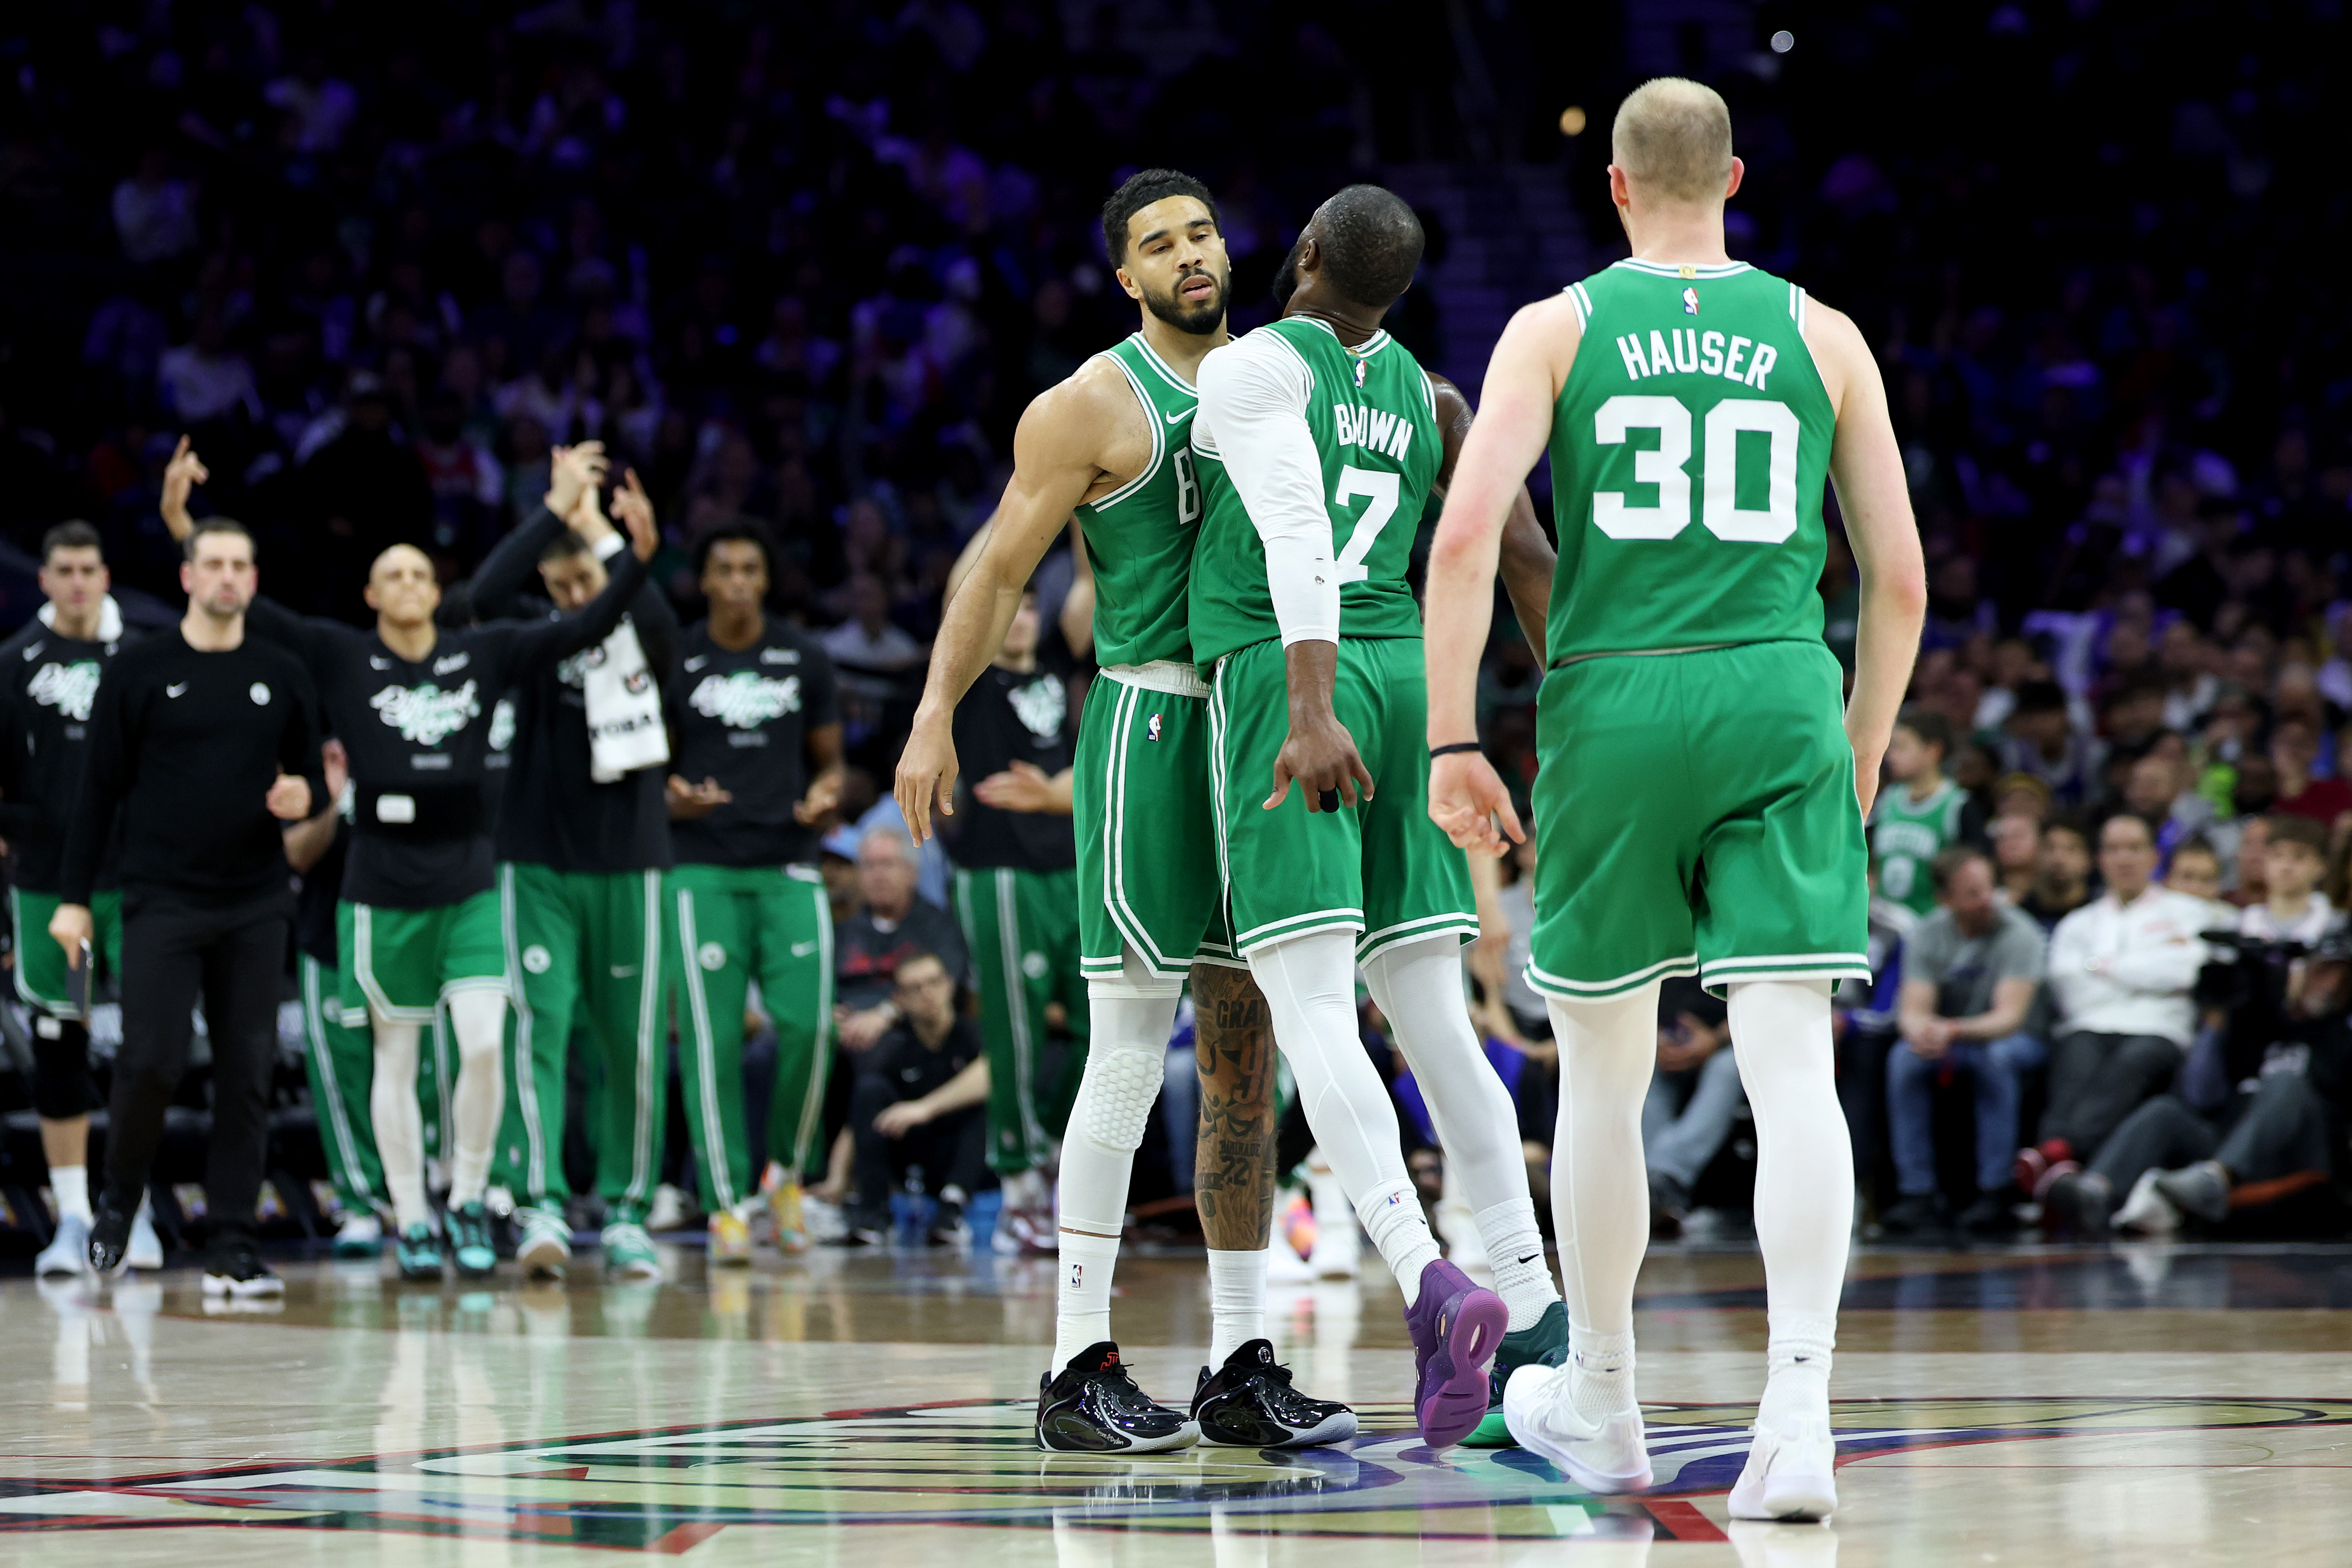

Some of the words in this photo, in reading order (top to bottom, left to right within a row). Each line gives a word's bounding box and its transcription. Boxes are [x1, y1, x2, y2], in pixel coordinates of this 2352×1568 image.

[1616, 328, 1778, 392] HAUSER
[1593, 395, 1800, 544] 30
[1335, 464, 1401, 586] 7
[1221, 1155, 1250, 1186] 22
